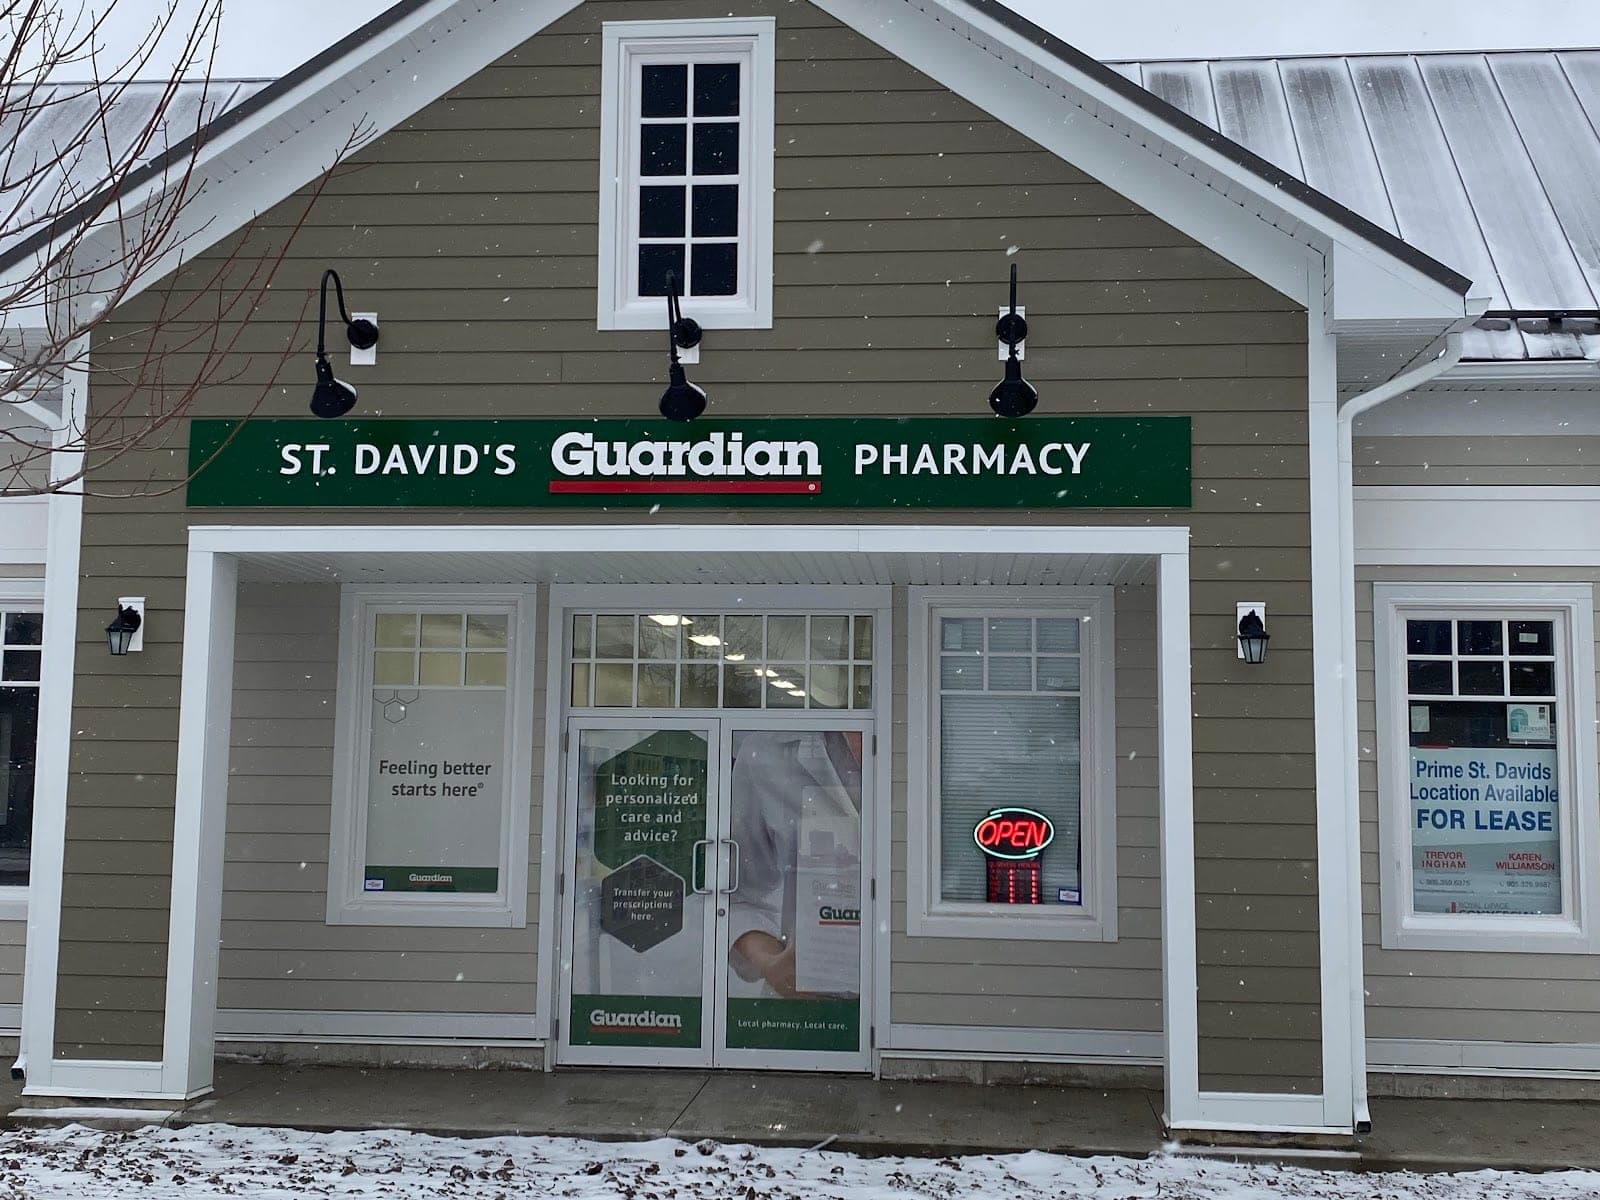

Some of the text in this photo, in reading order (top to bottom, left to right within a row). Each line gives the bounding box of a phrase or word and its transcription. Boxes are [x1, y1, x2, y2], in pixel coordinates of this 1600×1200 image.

[280, 431, 1091, 476] ST. DAVID'S Guardian PHARMACY
[379, 760, 491, 778] Feeling better
[1416, 760, 1551, 780] Prime St. Davids
[611, 773, 694, 788] Looking for
[391, 783, 437, 796] starts
[1410, 783, 1559, 802] Location Available
[606, 793, 698, 807] personalized
[621, 811, 682, 823] care and
[1417, 809, 1552, 831] FOR LEASE
[624, 829, 678, 841] advice?
[978, 821, 1047, 847] OPEN
[1424, 851, 1463, 859] TREVOR
[1508, 853, 1542, 861] KAREN
[1422, 860, 1466, 868] INGHAM
[1495, 862, 1555, 870] WILLIAMSON
[408, 873, 453, 882] Guardian
[613, 888, 674, 899] Transfer your
[613, 900, 673, 910] prescriptions
[631, 912, 655, 920] here.
[590, 1009, 682, 1027] Guardian
[738, 1019, 848, 1030] Local pharmacy. Local care.
